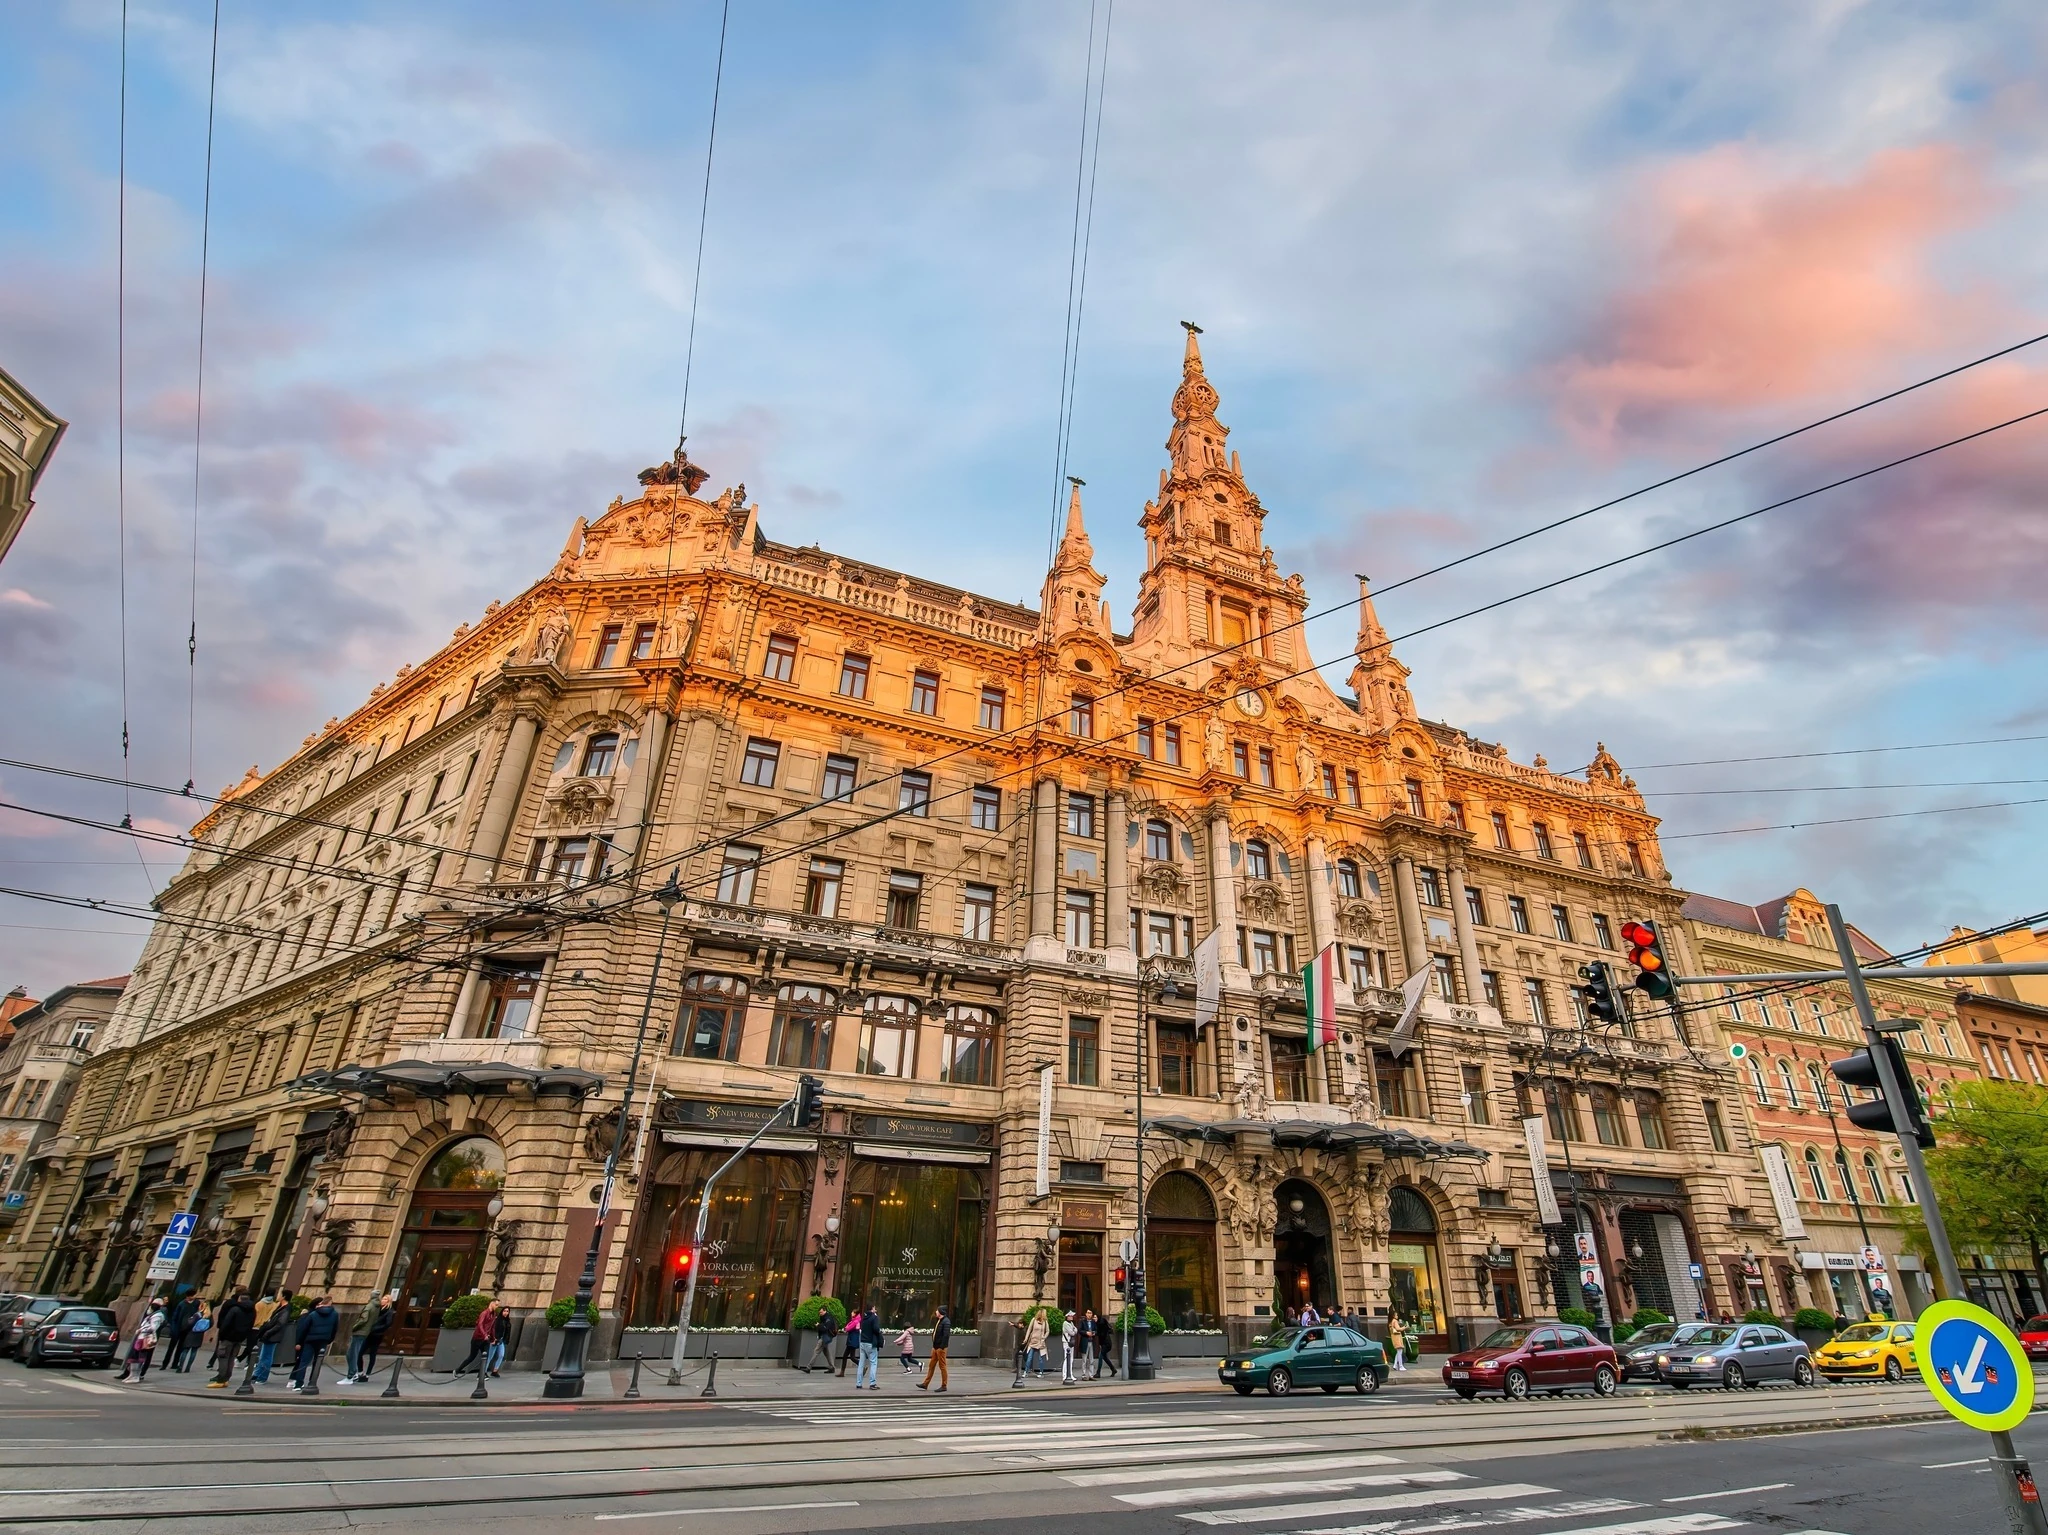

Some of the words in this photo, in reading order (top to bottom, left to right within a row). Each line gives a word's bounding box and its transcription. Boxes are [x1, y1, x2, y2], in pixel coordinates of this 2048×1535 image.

[720, 1109, 738, 1117] NEW
[739, 1111, 760, 1119] YORK
[916, 1124, 935, 1132] YORK
[936, 1126, 953, 1134] CAFÉ
[10, 1194, 21, 1203] P
[164, 1241, 179, 1255] P
[703, 1263, 728, 1271] YORK
[731, 1262, 754, 1272] CAFÉ
[877, 1267, 896, 1275] NEW
[897, 1267, 920, 1276] YORK
[922, 1267, 943, 1276] CAFÉ
